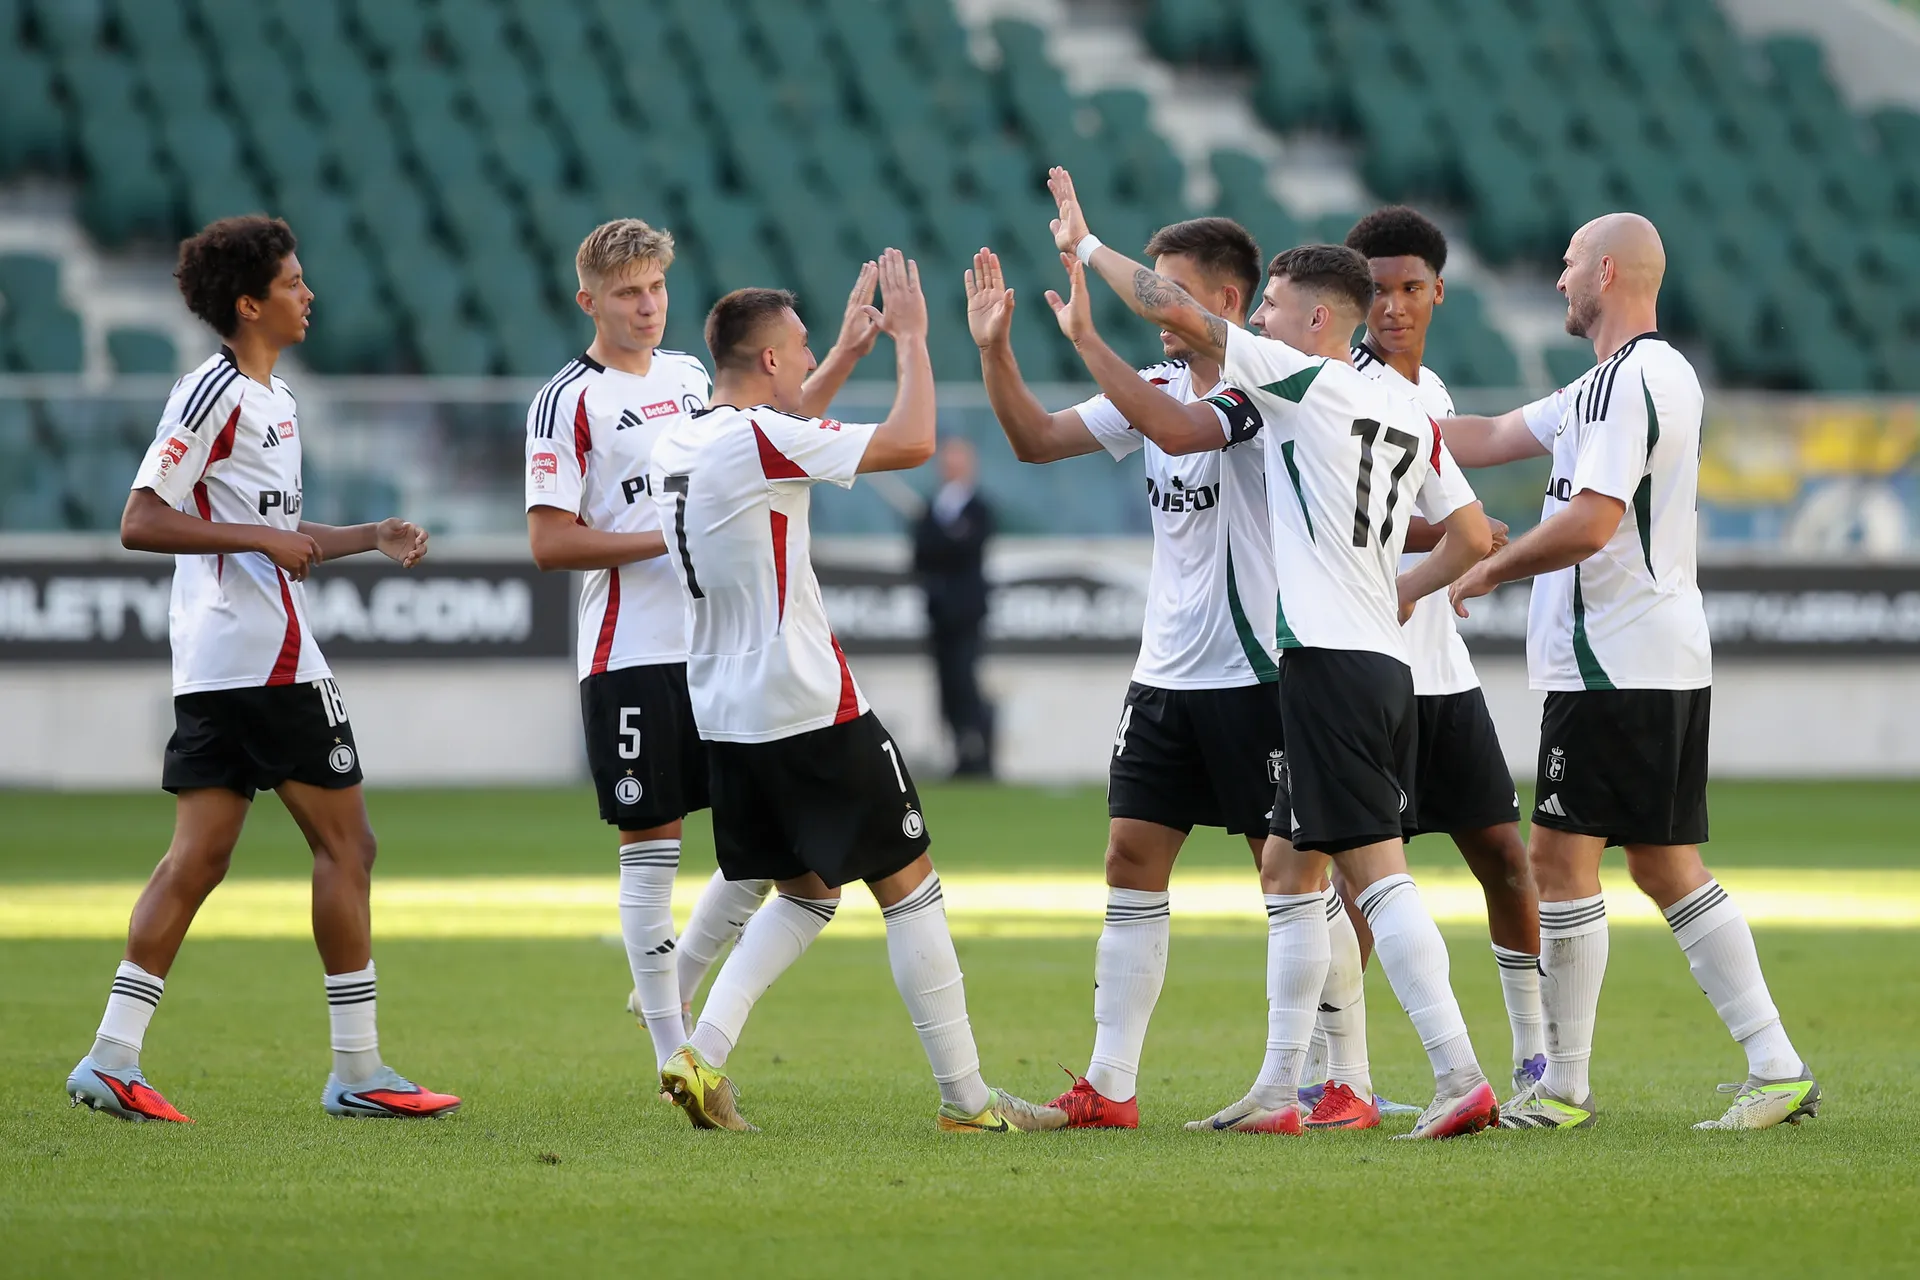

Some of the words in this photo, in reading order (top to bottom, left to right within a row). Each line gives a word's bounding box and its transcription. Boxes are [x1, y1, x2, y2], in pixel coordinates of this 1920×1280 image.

[645, 402, 675, 418] Betclic
[1351, 418, 1419, 548] 17
[312, 679, 349, 727] 18
[619, 707, 641, 759] 5
